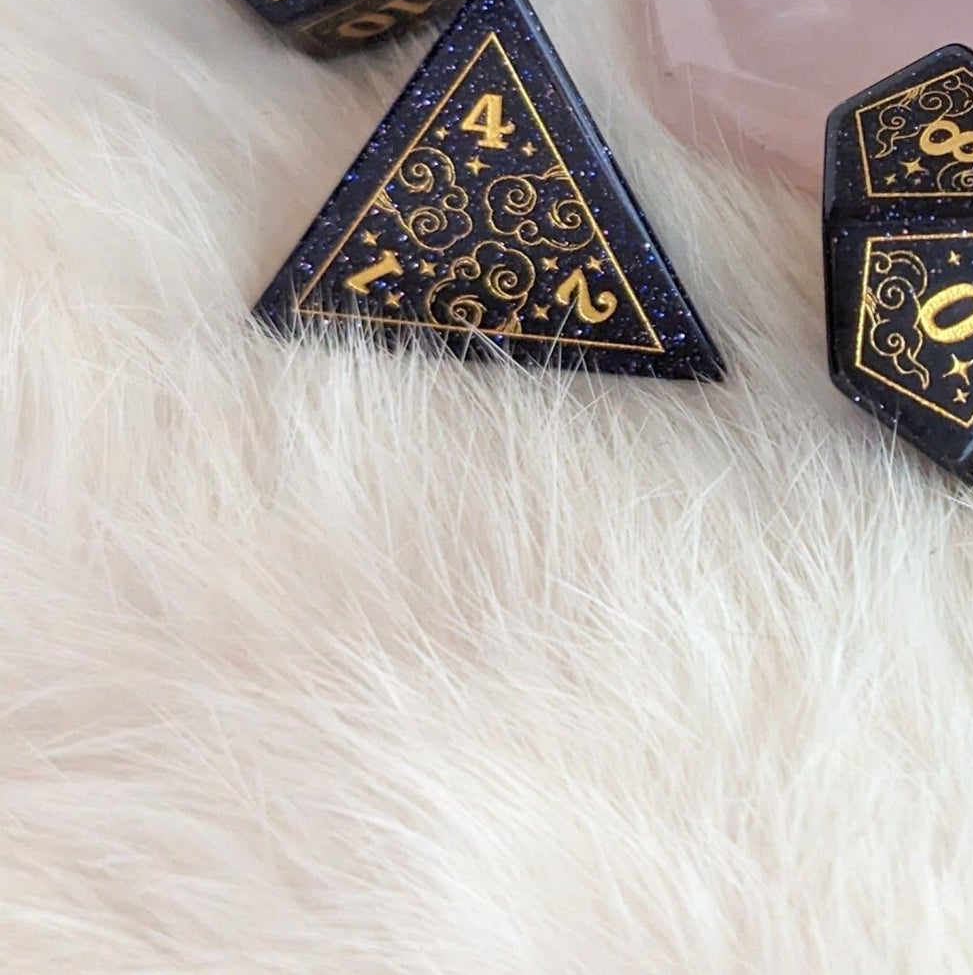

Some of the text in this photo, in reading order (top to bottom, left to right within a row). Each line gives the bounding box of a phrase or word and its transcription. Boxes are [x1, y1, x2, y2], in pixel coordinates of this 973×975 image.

[460, 93, 516, 149] 4
[344, 249, 404, 295] 1
[555, 268, 618, 324] 2
